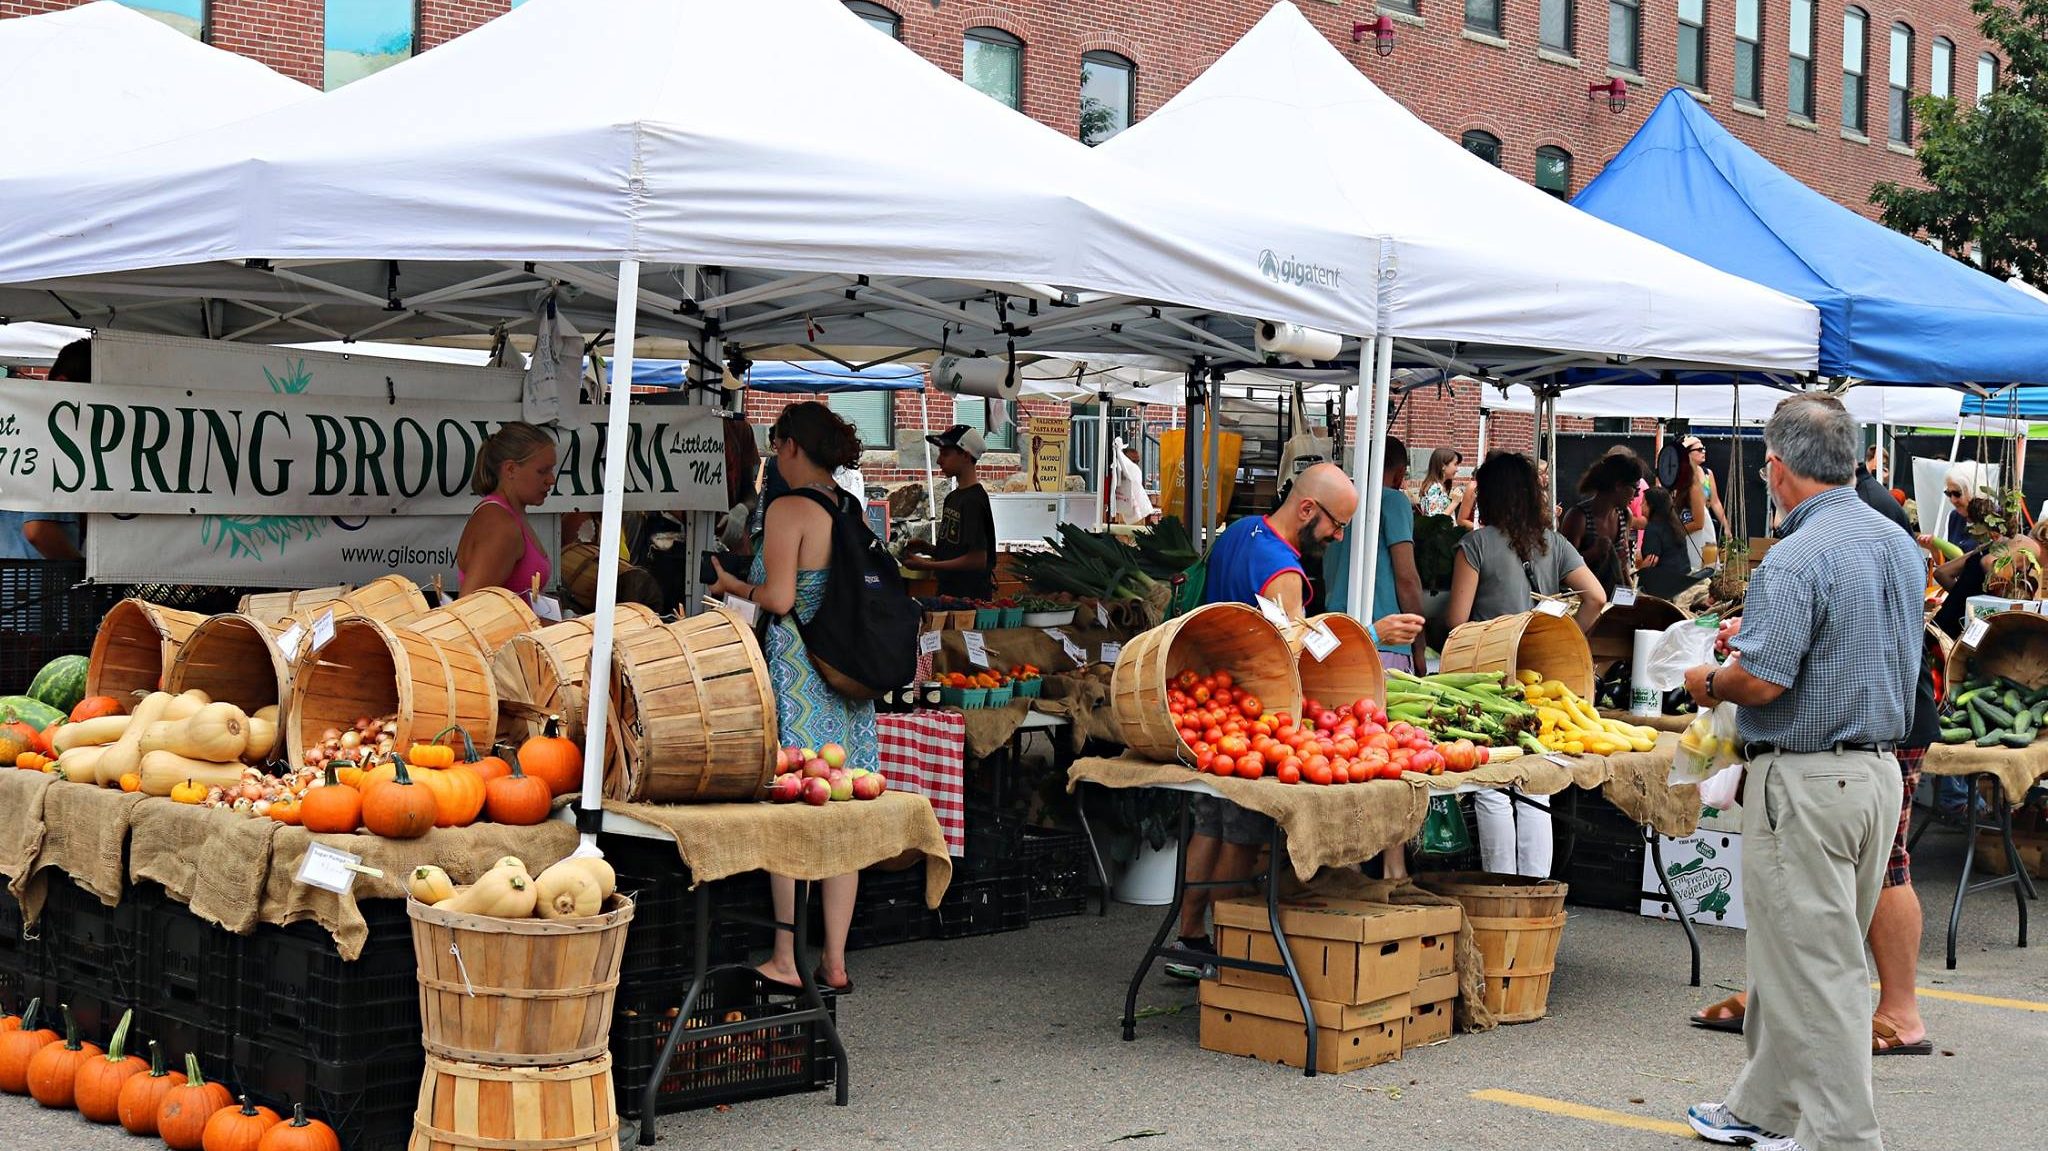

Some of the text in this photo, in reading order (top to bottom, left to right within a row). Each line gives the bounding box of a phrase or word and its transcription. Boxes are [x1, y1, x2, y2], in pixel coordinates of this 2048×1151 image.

[1281, 255, 1341, 288] gigatent
[48, 401, 294, 496] SPRING
[536, 422, 679, 496] ARM
[670, 431, 724, 454] Littleton
[689, 460, 722, 485] MA
[1676, 871, 1728, 900] Vegetables
[1687, 870, 1708, 887] Fresh
